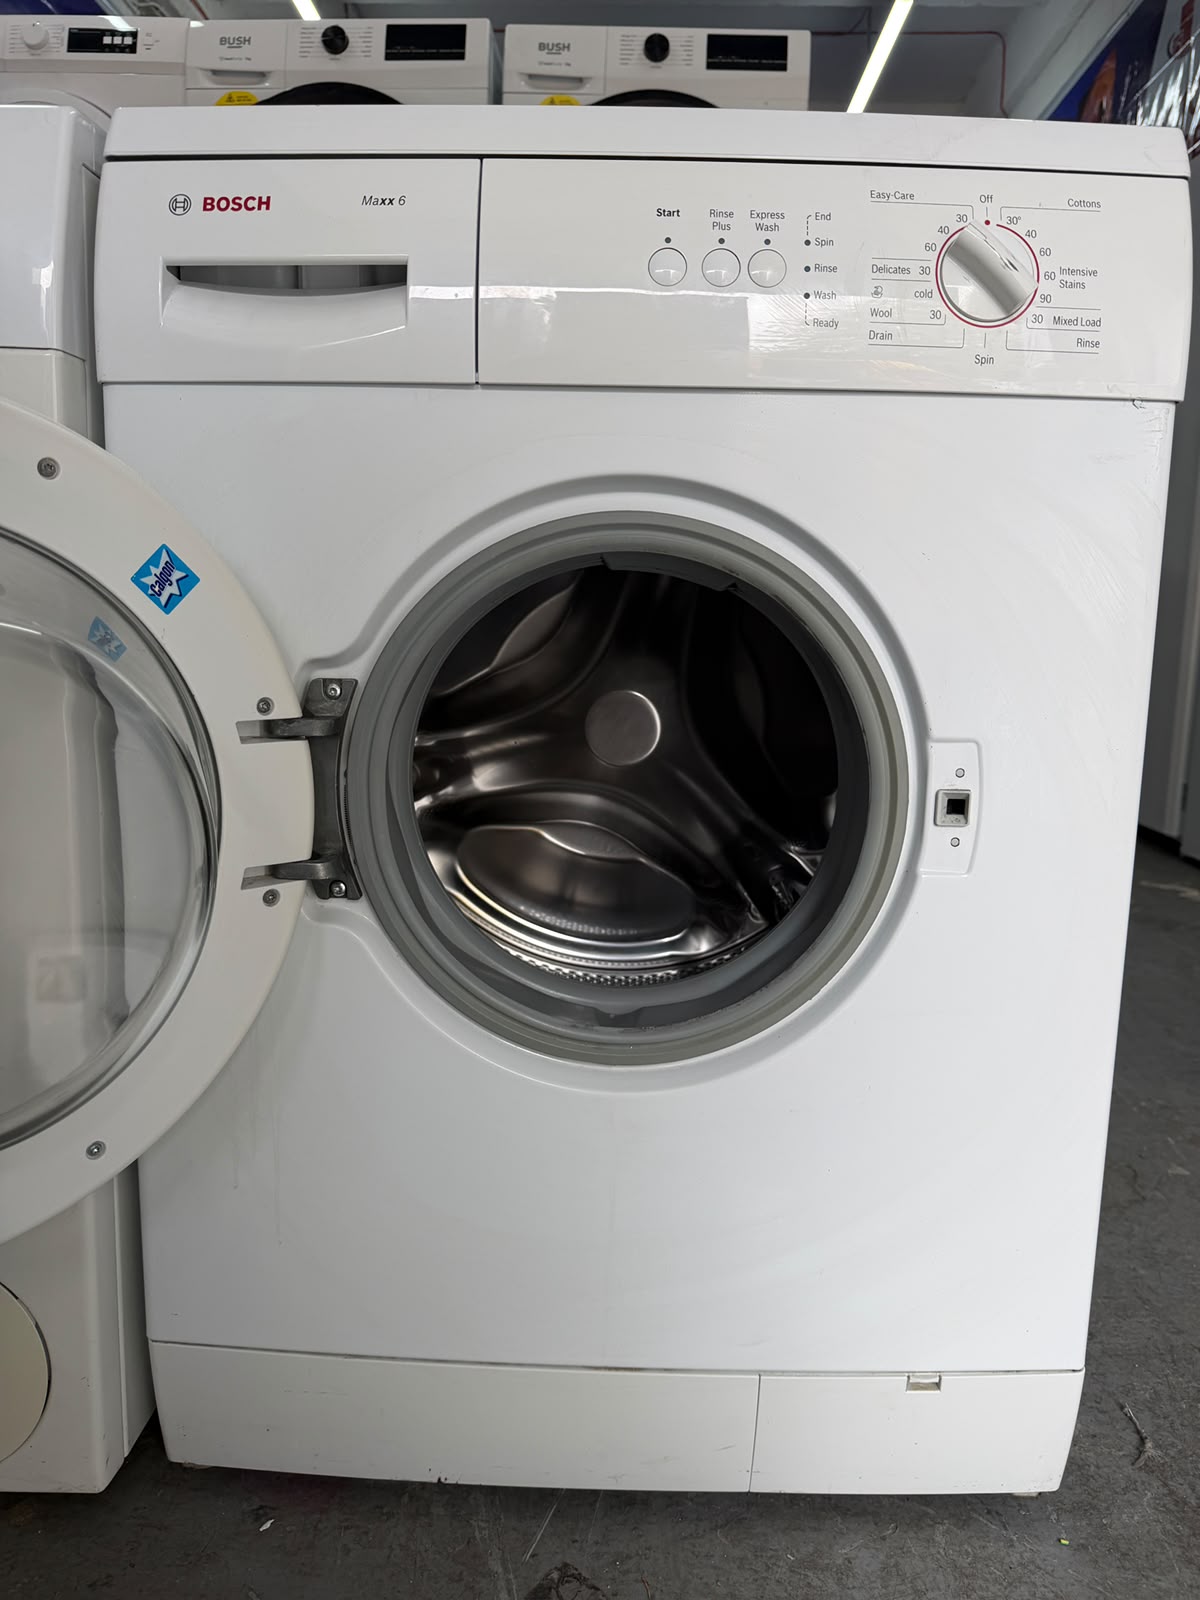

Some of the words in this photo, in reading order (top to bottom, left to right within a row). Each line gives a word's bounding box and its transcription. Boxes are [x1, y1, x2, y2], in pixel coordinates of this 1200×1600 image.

[219, 36, 251, 46] BUSH
[538, 42, 571, 52] BUSH
[870, 190, 915, 200] Easy-Care
[979, 195, 993, 204] Off
[202, 196, 271, 212] BOSCH
[361, 196, 395, 206] Maxx
[398, 196, 406, 206] 6
[1067, 199, 1101, 208] Cottons
[656, 208, 680, 217] Start
[709, 209, 734, 218] Rinse
[750, 210, 785, 221] Express
[815, 213, 831, 221] End
[956, 214, 968, 223] 30
[712, 222, 731, 231] Plus
[755, 223, 779, 231] Wash
[937, 226, 950, 235] 40
[1025, 230, 1037, 239] 40
[814, 238, 834, 247] Spin
[924, 243, 937, 252] 60
[1039, 248, 1052, 257] 60
[814, 264, 837, 273] Rinse
[871, 264, 911, 275] Delicates
[919, 266, 931, 275] 30
[1059, 267, 1098, 277] Intensive
[1044, 272, 1056, 281] 60
[1059, 280, 1086, 289] Stains
[814, 291, 836, 299] Wash
[914, 289, 933, 299] cold
[1040, 294, 1052, 303] 90
[870, 308, 892, 318] Wool
[929, 310, 942, 320] 30
[813, 319, 839, 329] Ready
[1031, 315, 1043, 324] 30
[1053, 316, 1078, 326] Mixed
[1080, 317, 1101, 327] Load
[868, 331, 893, 340] Drain
[1076, 338, 1100, 348] Rinse
[974, 354, 994, 366] Spin
[149, 560, 175, 597] Calgon
